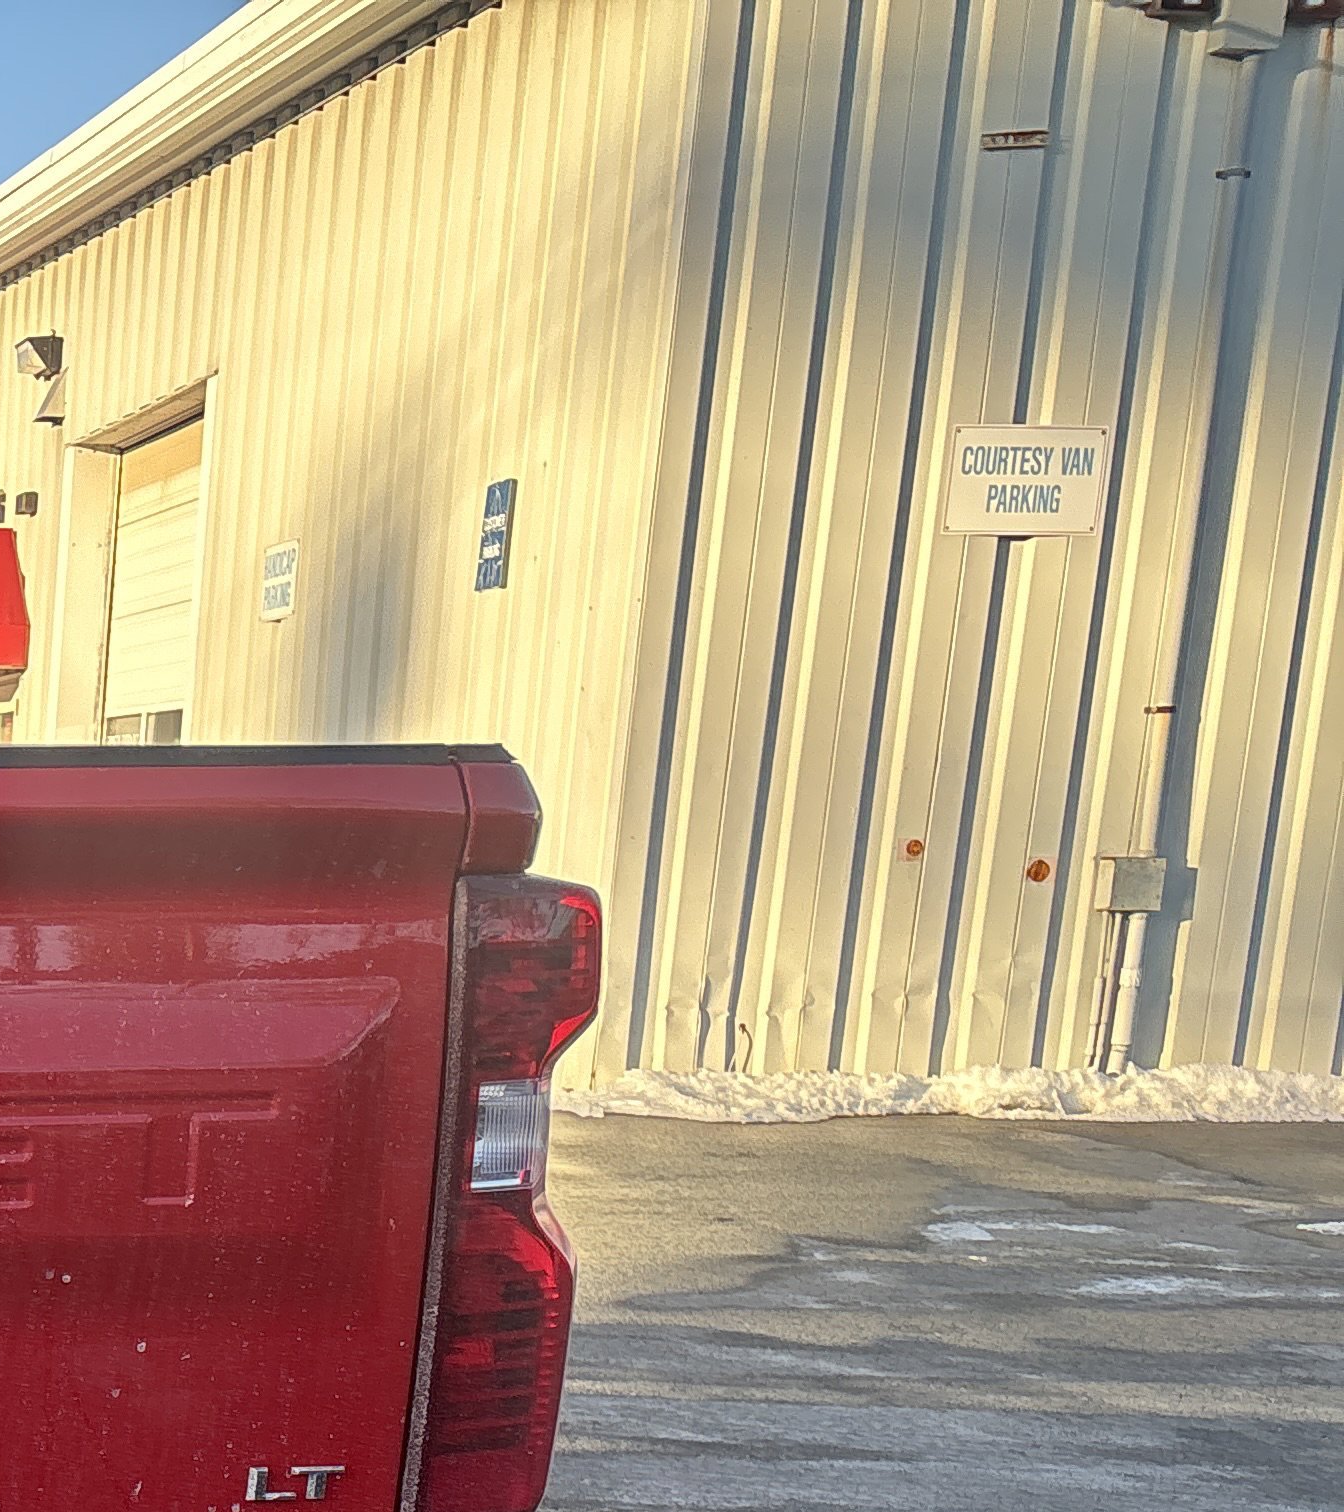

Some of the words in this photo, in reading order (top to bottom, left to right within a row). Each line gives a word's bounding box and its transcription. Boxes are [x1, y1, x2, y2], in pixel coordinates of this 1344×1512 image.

[961, 445, 1054, 476] COURTESY
[1061, 446, 1095, 476] VAN
[985, 484, 1062, 513] PARKING
[263, 581, 291, 611] PARKING
[245, 1465, 345, 1501] LT
